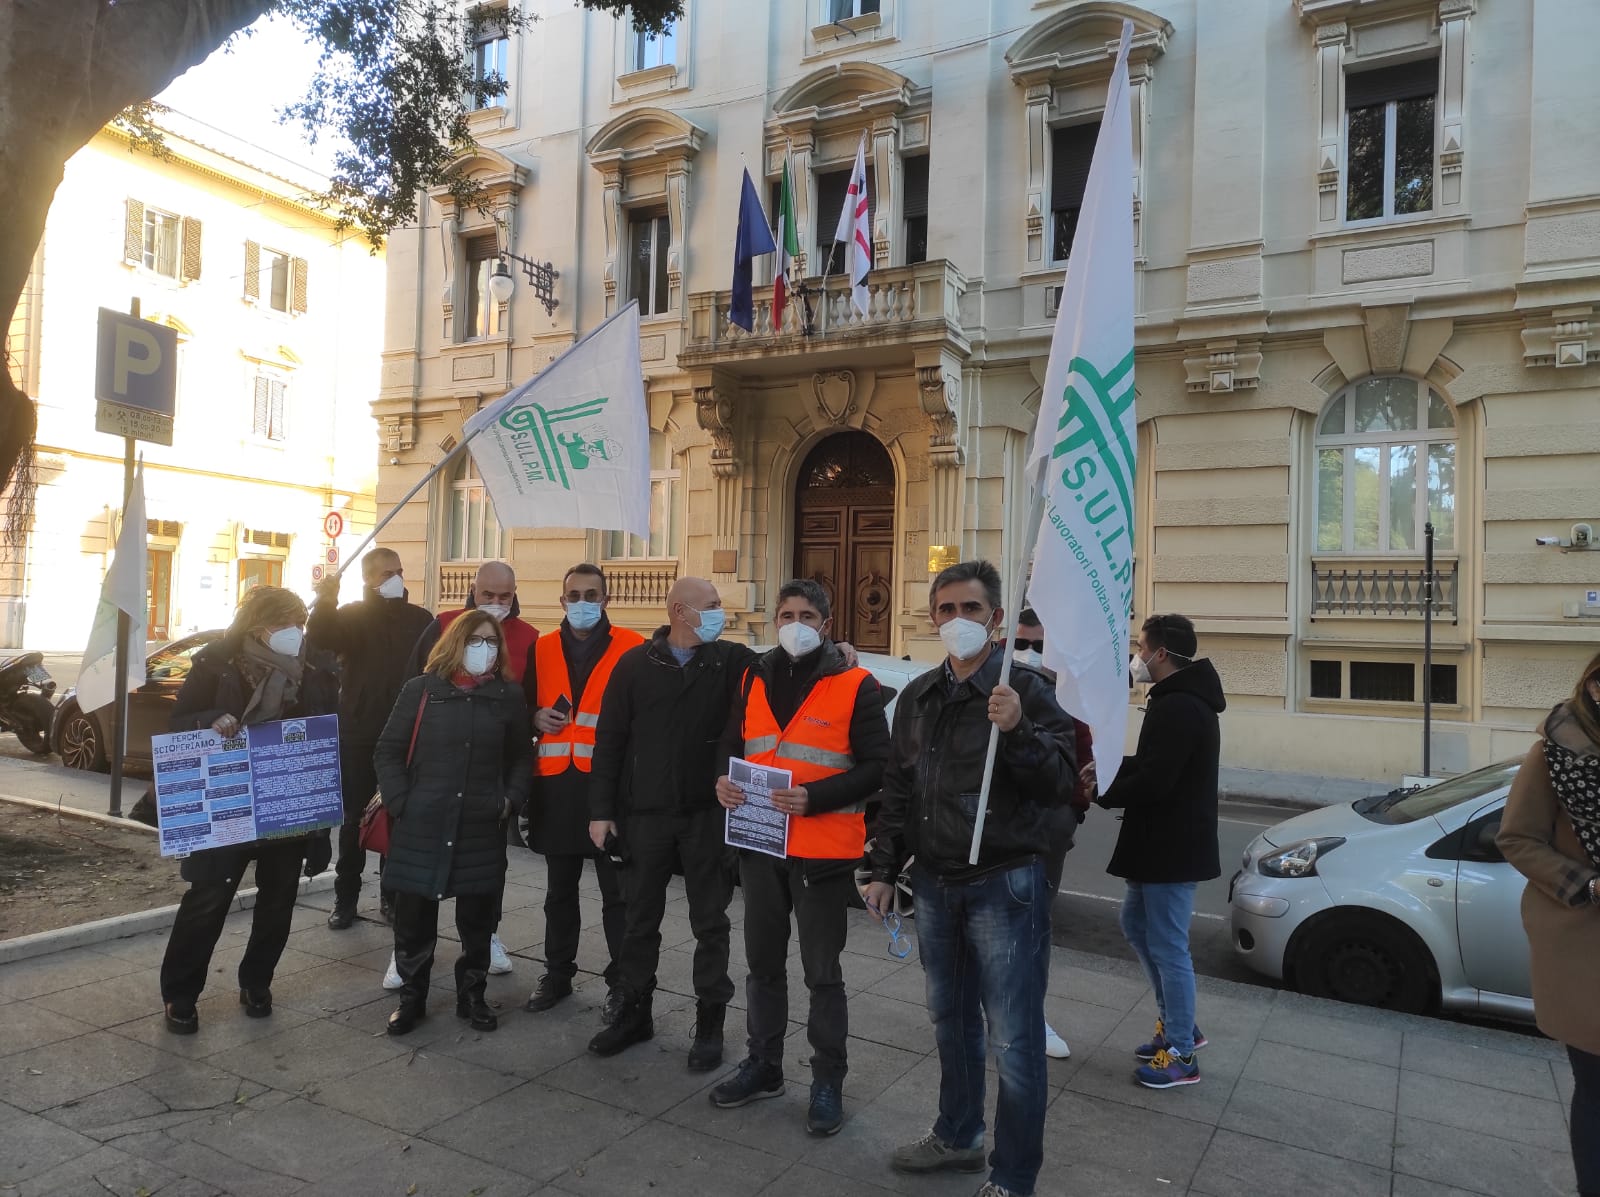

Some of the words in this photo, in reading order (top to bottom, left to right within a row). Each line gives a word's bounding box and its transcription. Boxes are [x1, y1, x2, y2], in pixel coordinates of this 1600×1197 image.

[114, 323, 162, 395] P
[511, 432, 544, 484] S.U.L.P.M.
[1048, 505, 1092, 569] Lavoratori
[1087, 569, 1110, 614] Polizia
